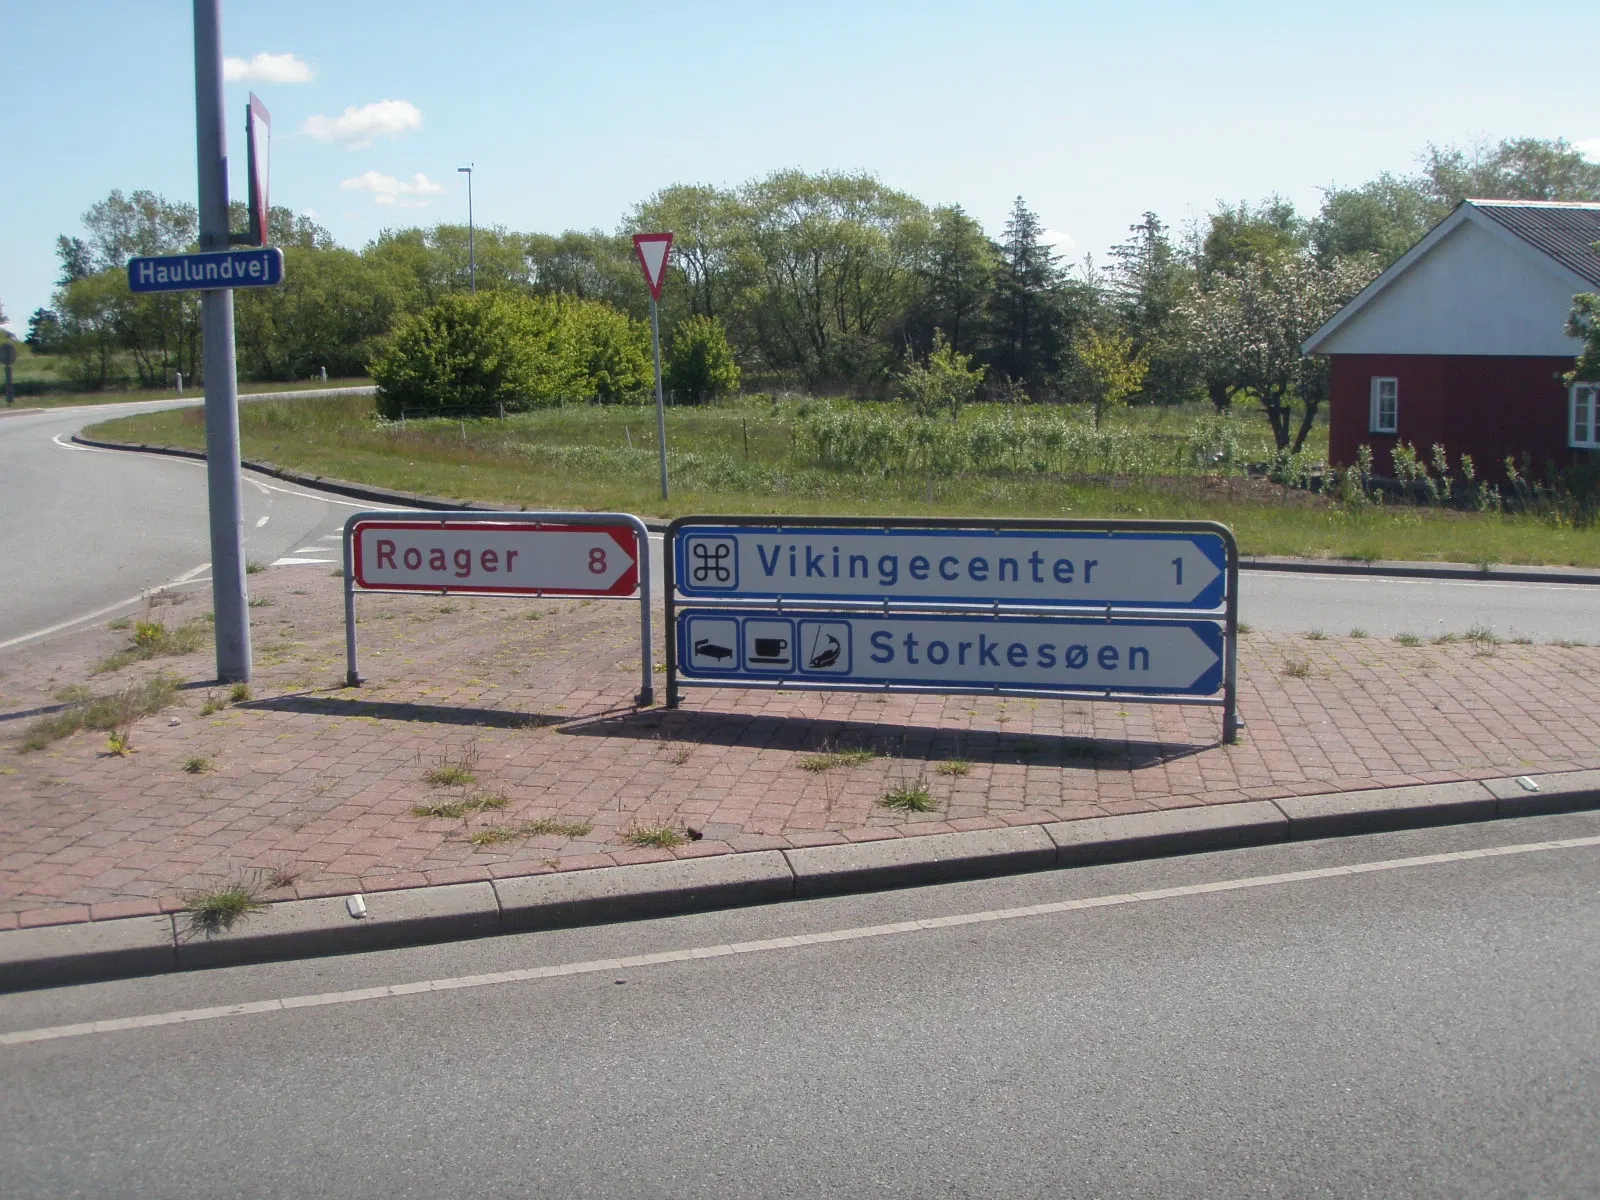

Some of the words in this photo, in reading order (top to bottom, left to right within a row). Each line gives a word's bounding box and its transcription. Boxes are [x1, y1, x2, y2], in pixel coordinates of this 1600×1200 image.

[139, 254, 269, 284] Haulundvej
[376, 539, 519, 578] Roager
[588, 547, 608, 575] 8
[756, 543, 1099, 587] Vikingecenter
[1171, 557, 1183, 586] 1
[869, 630, 1150, 671] Storkesøen
